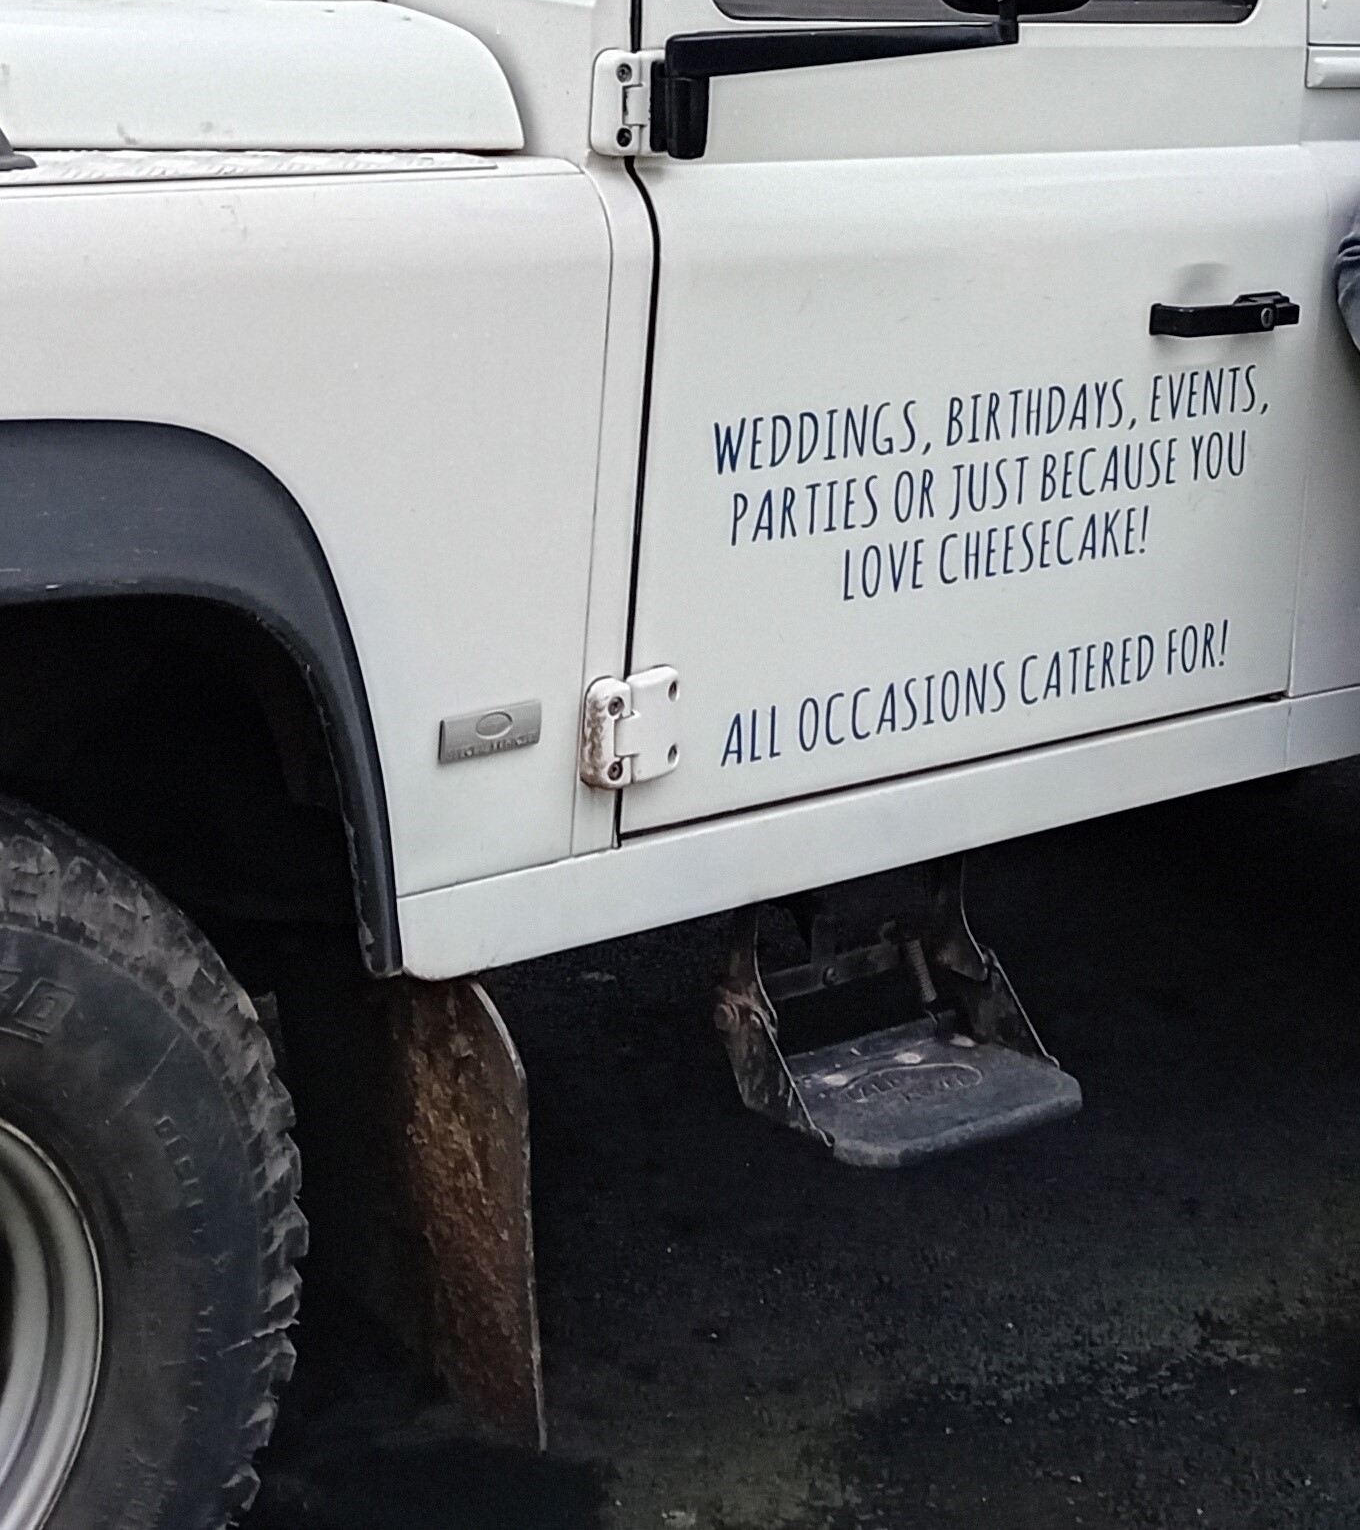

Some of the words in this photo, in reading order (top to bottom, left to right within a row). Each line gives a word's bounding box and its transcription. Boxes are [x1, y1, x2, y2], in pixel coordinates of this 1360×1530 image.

[713, 400, 932, 475] WEDDINGS,
[946, 378, 1137, 447] BIRTHDAYS,
[1150, 364, 1269, 422] EVENTS,
[731, 474, 878, 547] PARTIES
[894, 468, 935, 524] OR
[948, 456, 1029, 521] JUST
[1040, 437, 1178, 502] BECAUSE
[1191, 429, 1247, 481] YOU
[843, 538, 925, 601] LOVE
[939, 505, 1149, 585] CHEESECAKE!
[720, 696, 782, 767] ALL
[798, 660, 1006, 752] OCCASIONS
[1020, 634, 1155, 705] CATERED
[1167, 619, 1229, 675] FOR!
